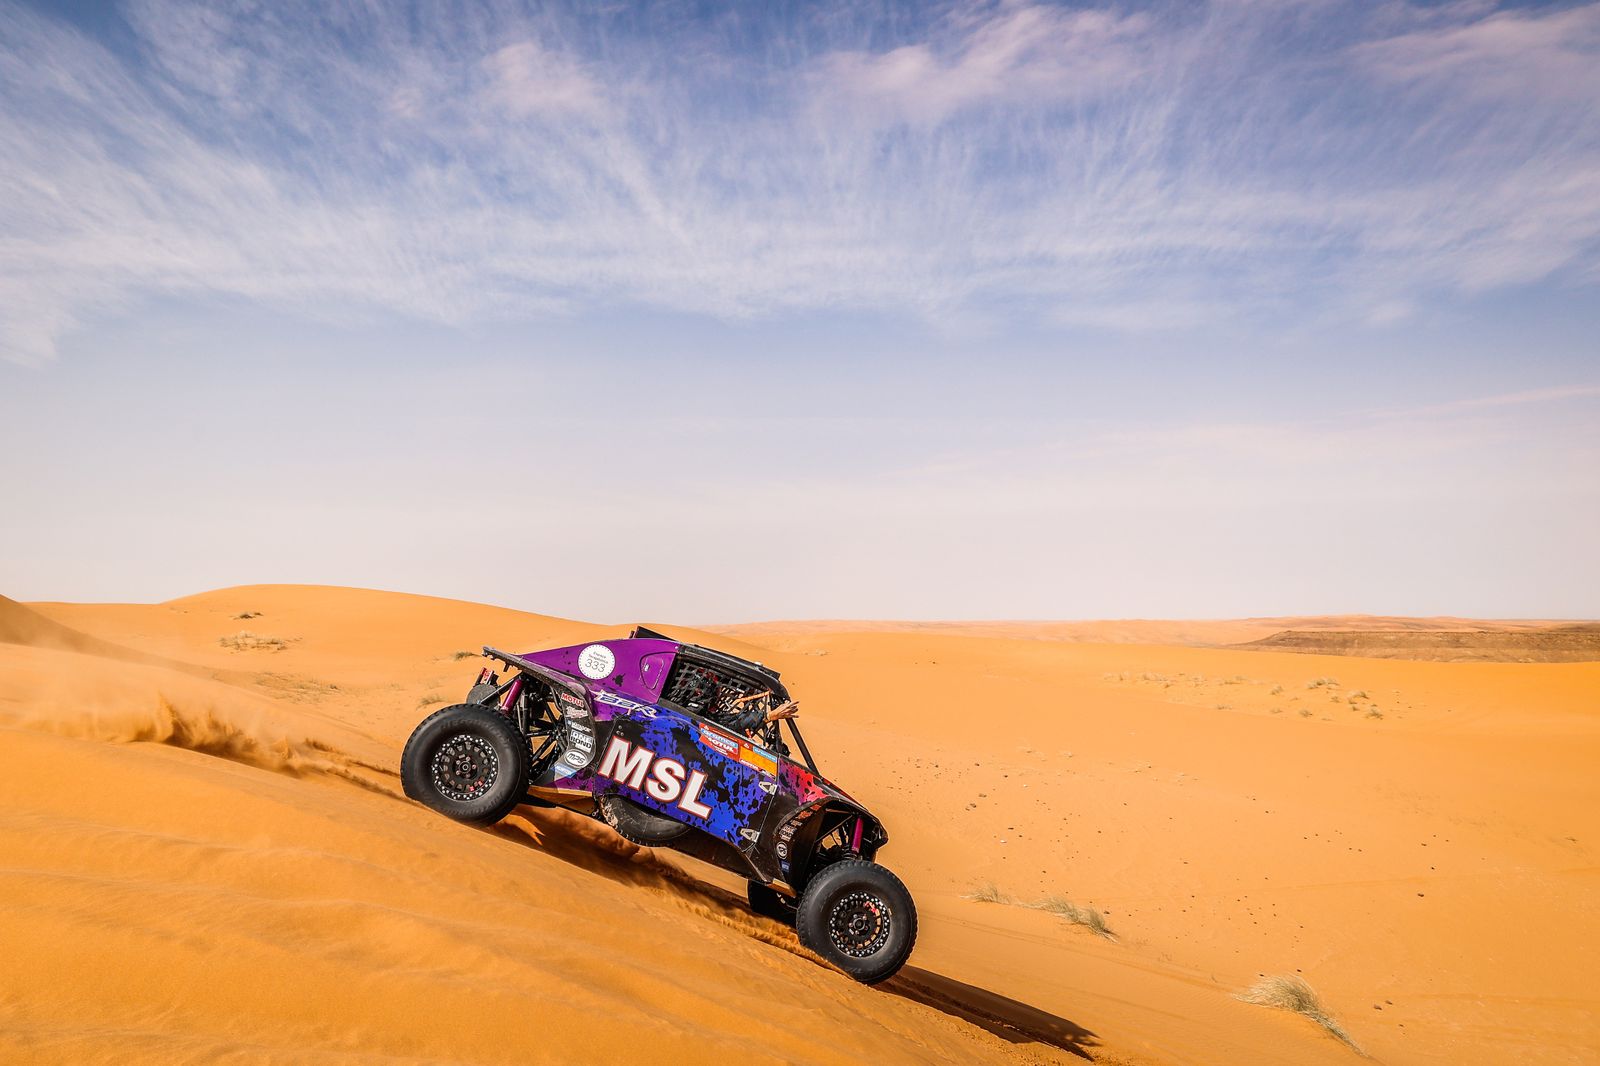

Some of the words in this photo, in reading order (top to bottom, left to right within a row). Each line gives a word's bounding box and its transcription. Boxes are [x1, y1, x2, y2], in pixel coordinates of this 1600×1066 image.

[585, 658, 606, 673] 333
[561, 693, 585, 708] MOTUL
[701, 728, 738, 748] aramco
[597, 735, 713, 822] MSL
